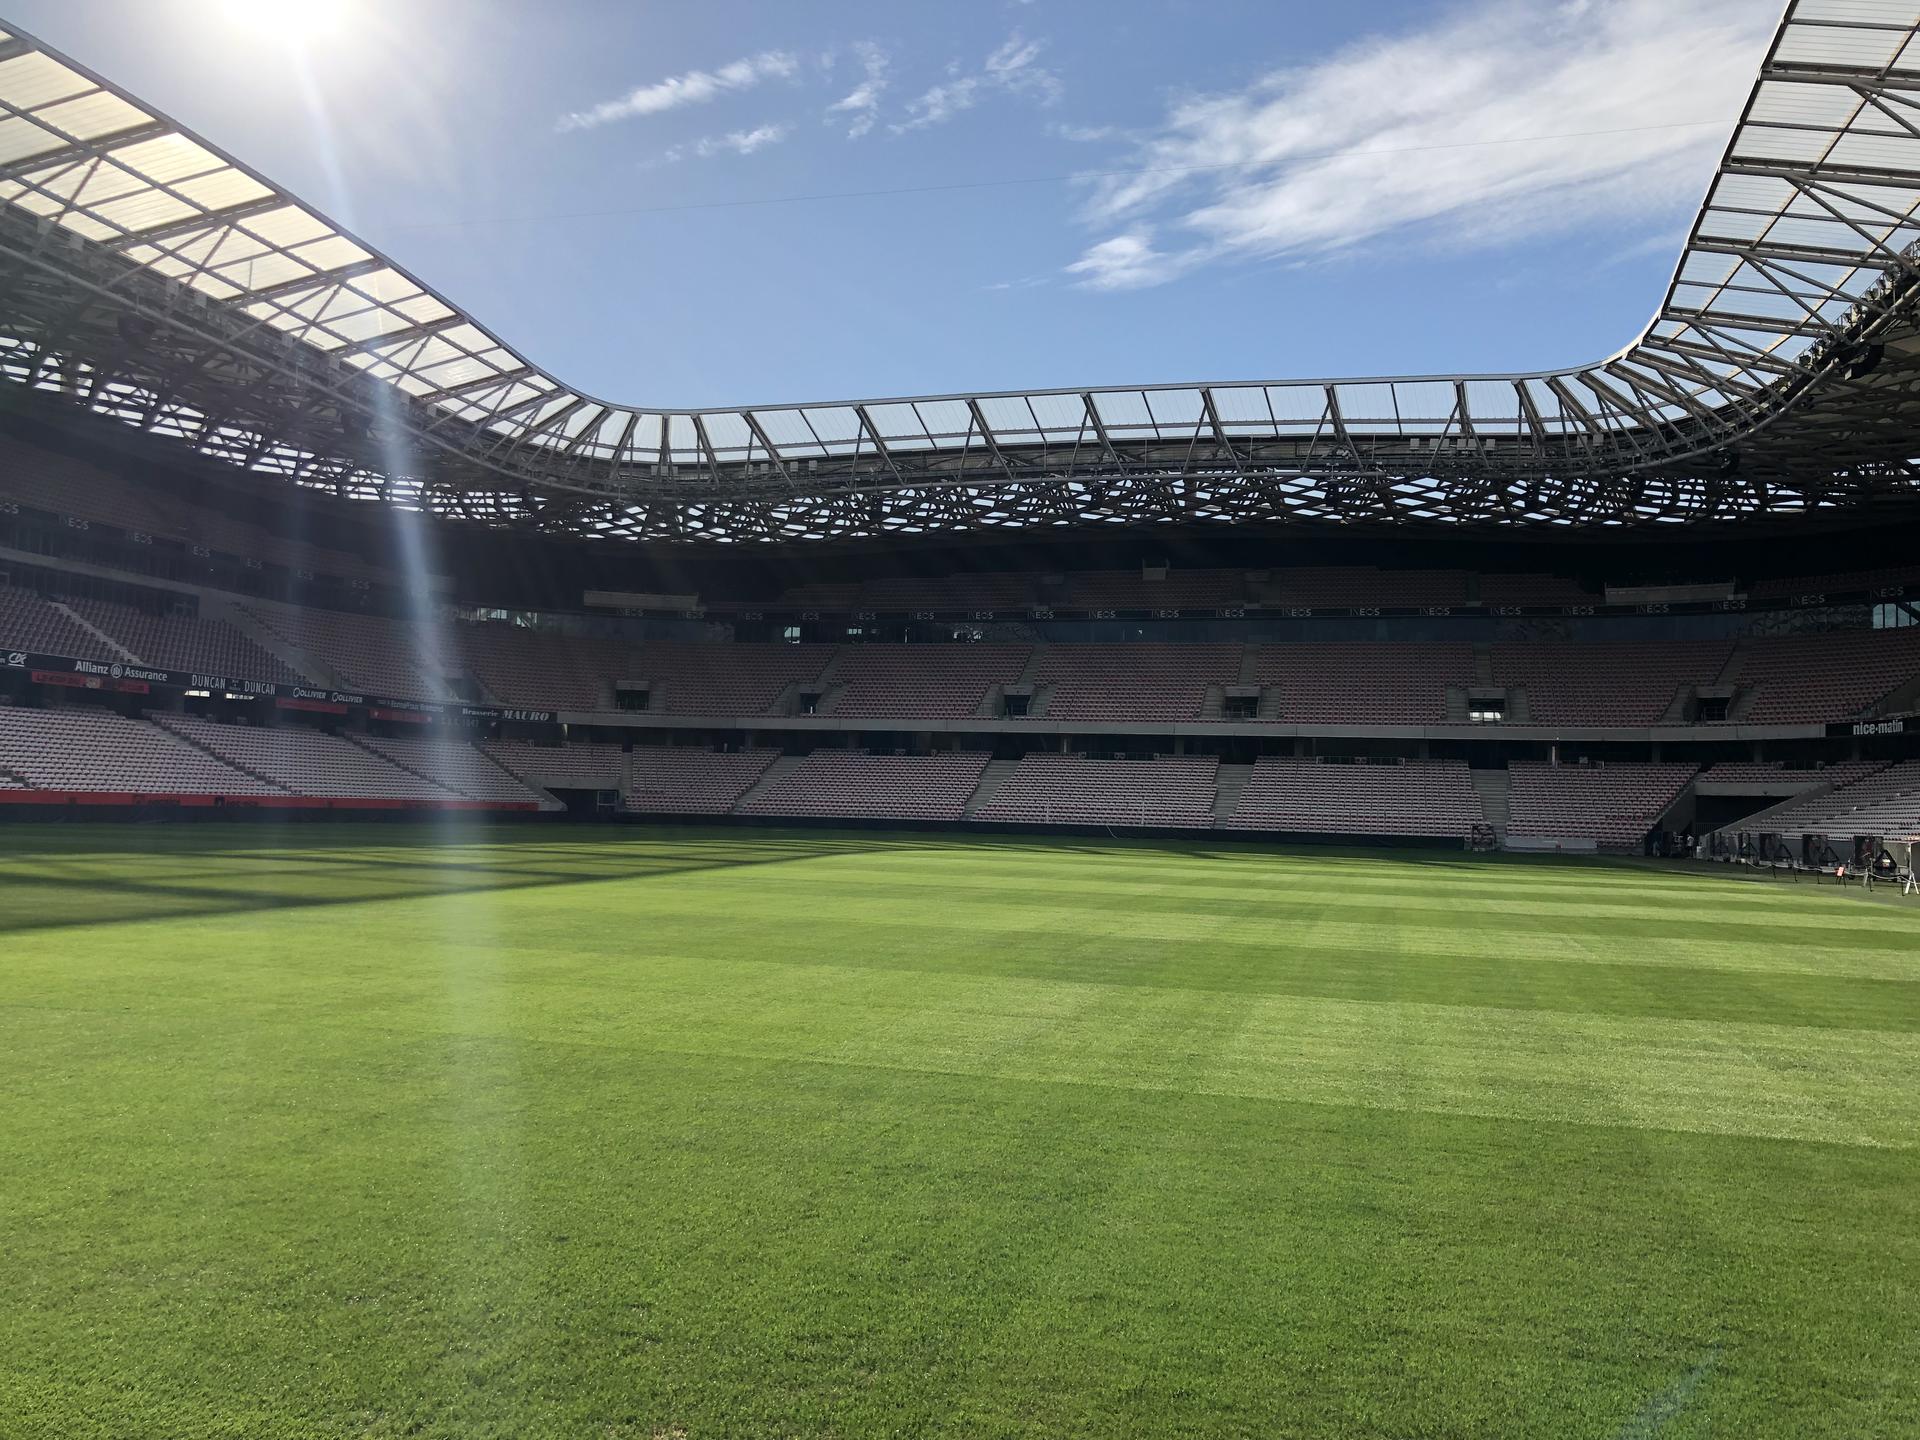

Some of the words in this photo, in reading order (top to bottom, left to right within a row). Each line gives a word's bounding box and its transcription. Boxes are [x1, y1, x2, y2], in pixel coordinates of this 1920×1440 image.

[1869, 586, 1905, 600] INEOS
[1712, 600, 1746, 611] INEOS
[1790, 594, 1825, 607] INEOS
[1349, 607, 1380, 617] INEOS
[1420, 607, 1450, 617] INEOS
[1490, 606, 1521, 616] INEOS
[1563, 606, 1595, 616] INEOS
[1636, 604, 1669, 615] INEOS
[75, 660, 109, 676] Allianz
[124, 666, 168, 682] Assurance
[192, 674, 226, 690] DUNCAN
[244, 680, 276, 696] DUNCAN
[503, 709, 550, 722] MAURO
